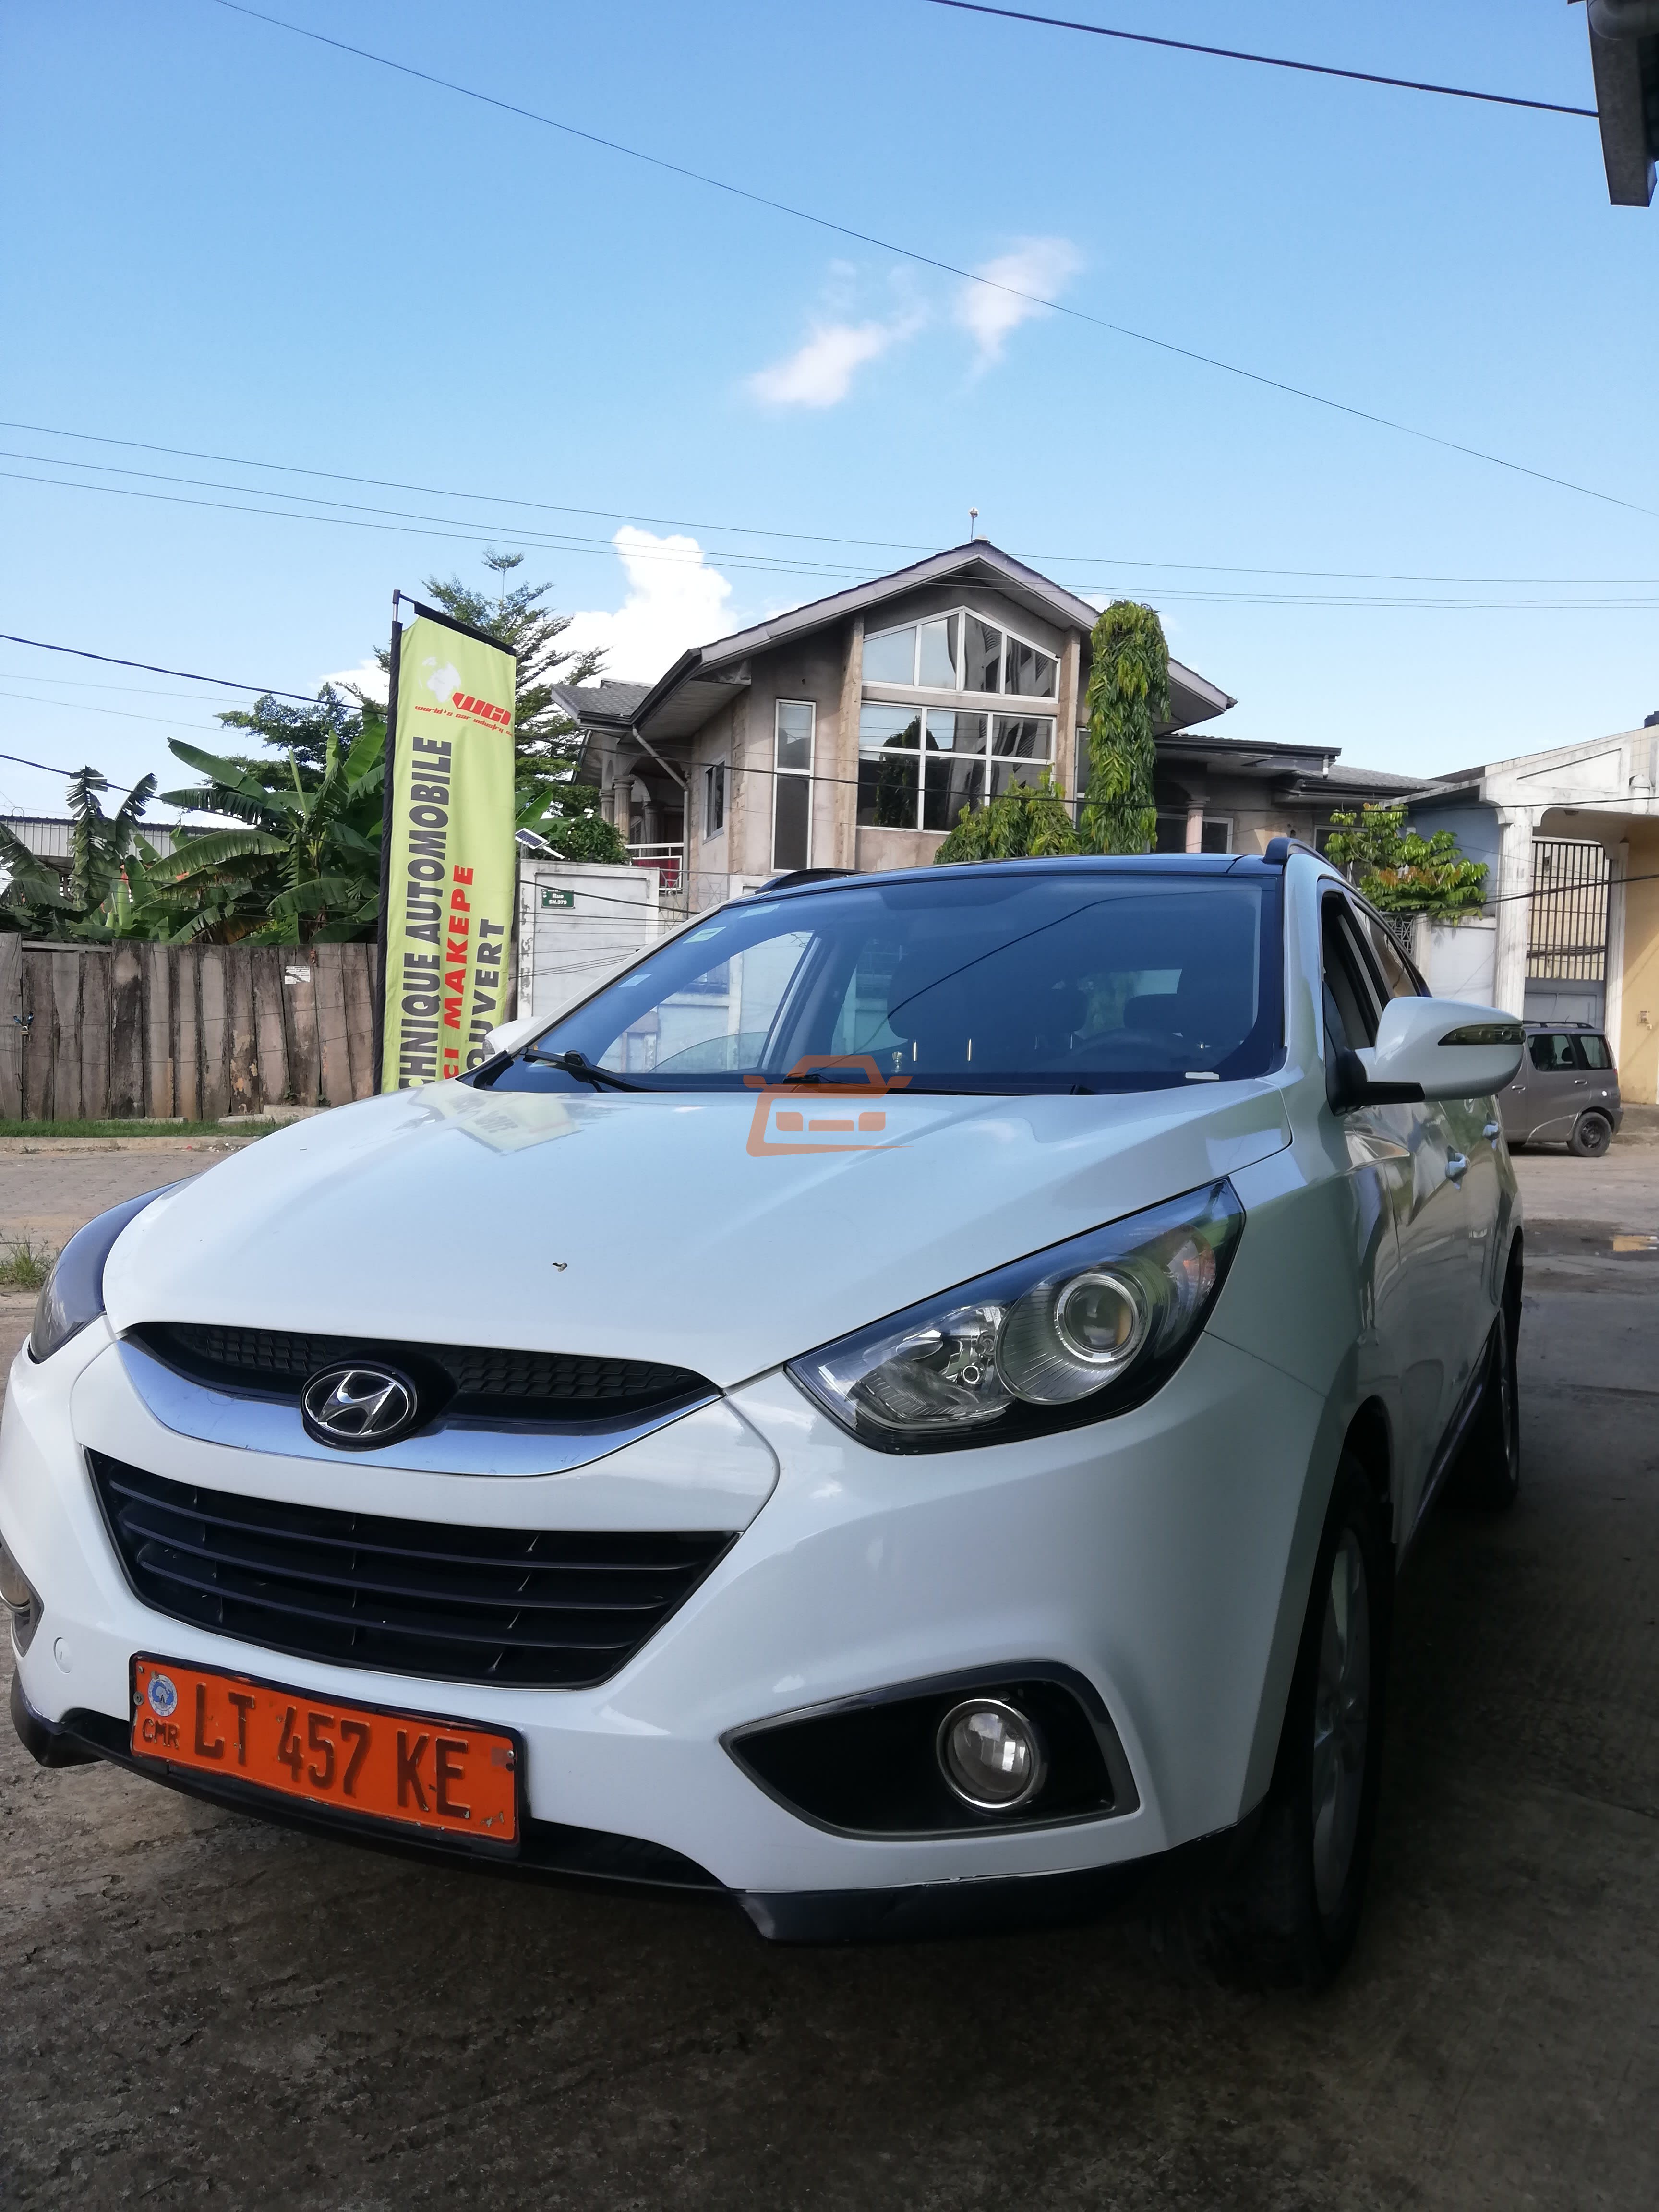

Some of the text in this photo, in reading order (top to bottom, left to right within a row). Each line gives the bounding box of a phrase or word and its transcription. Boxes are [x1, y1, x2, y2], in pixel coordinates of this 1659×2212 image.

[473, 719, 504, 733] industry
[405, 736, 452, 946] AUTOMOBILE
[444, 865, 474, 1030] MAKEPE
[467, 918, 505, 1070] OUVERT
[142, 1717, 180, 1749] CMR
[195, 1682, 256, 1766] LT
[277, 1705, 372, 1798] 457
[397, 1727, 471, 1819] KE
